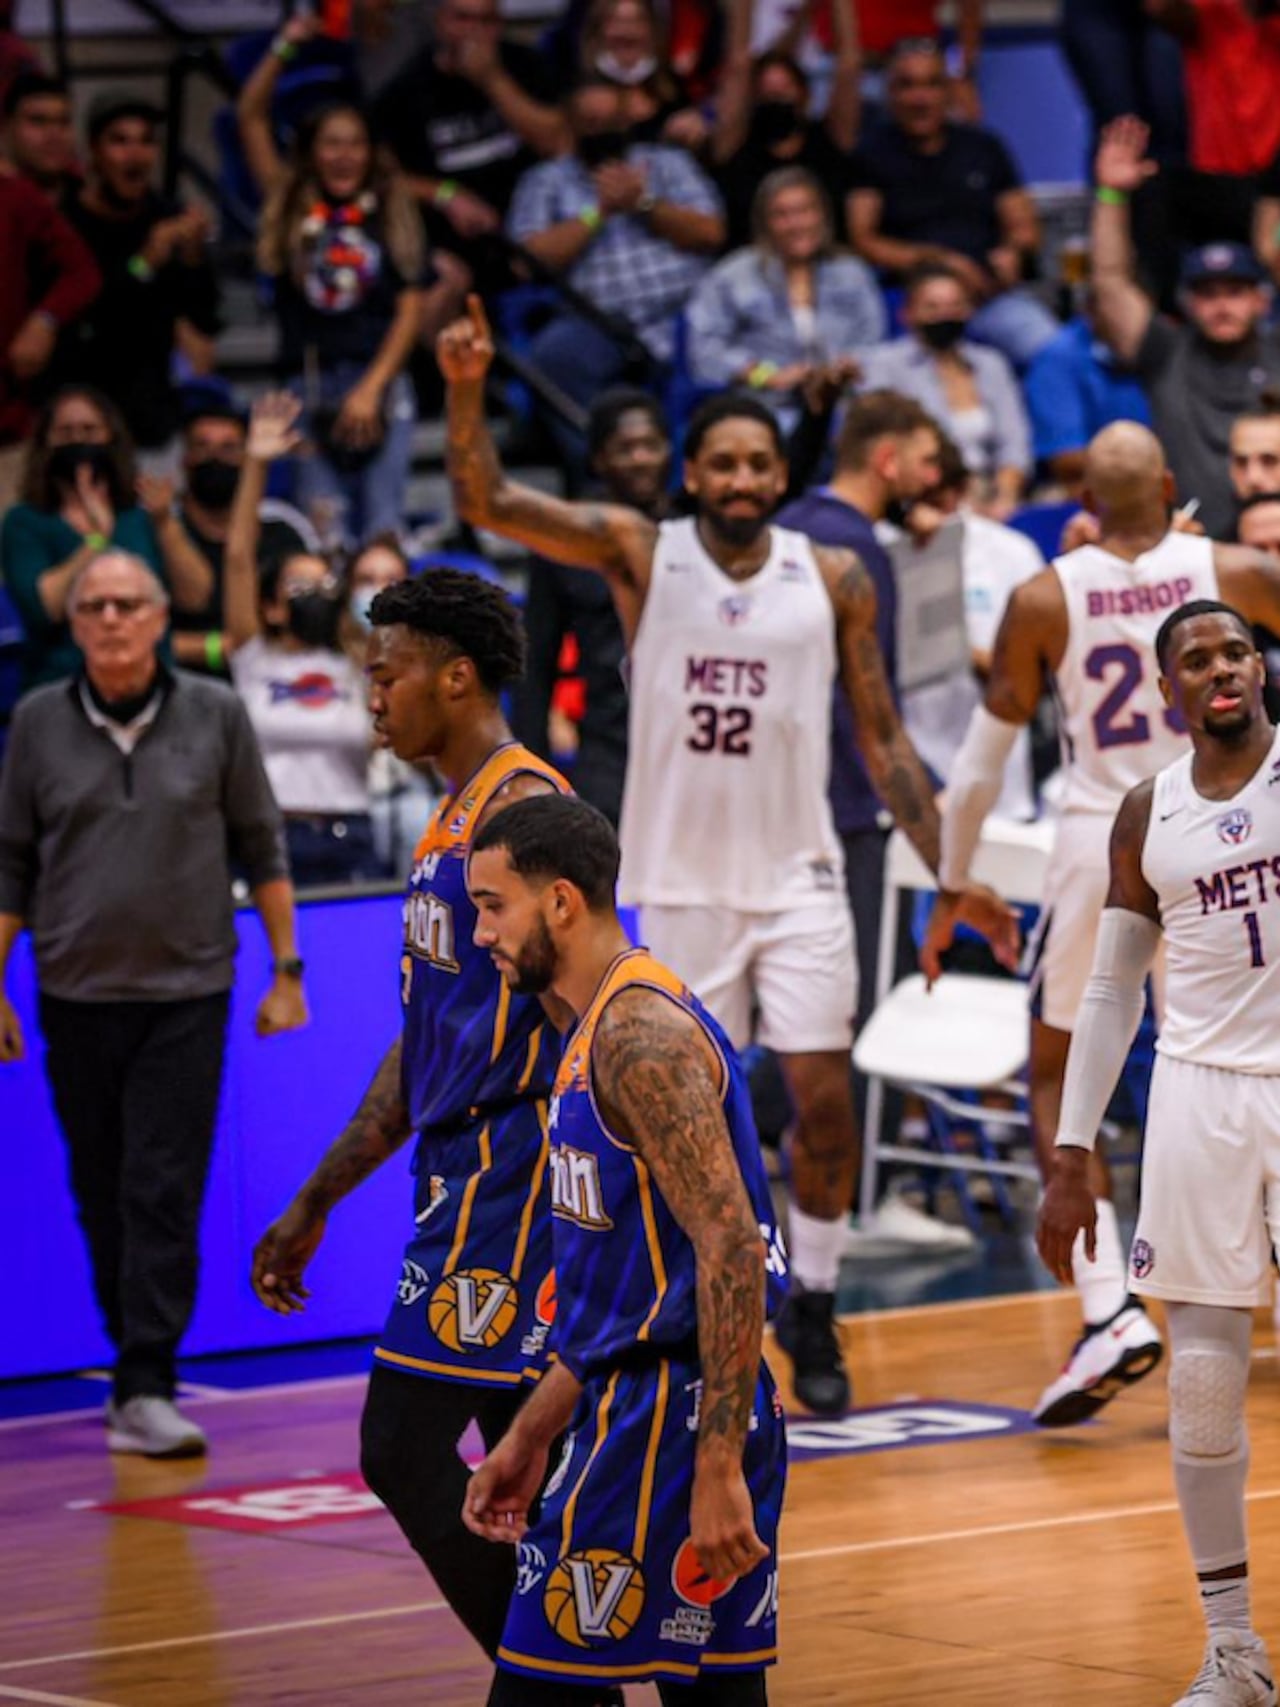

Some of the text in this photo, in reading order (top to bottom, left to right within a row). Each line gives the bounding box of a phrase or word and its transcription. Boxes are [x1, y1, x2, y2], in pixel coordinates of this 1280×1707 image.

[1087, 578, 1192, 617] BISHOP
[684, 656, 767, 697] METS
[686, 703, 753, 756] 32
[1243, 912, 1265, 968] 1
[448, 1274, 515, 1346] V
[560, 1557, 635, 1637] V
